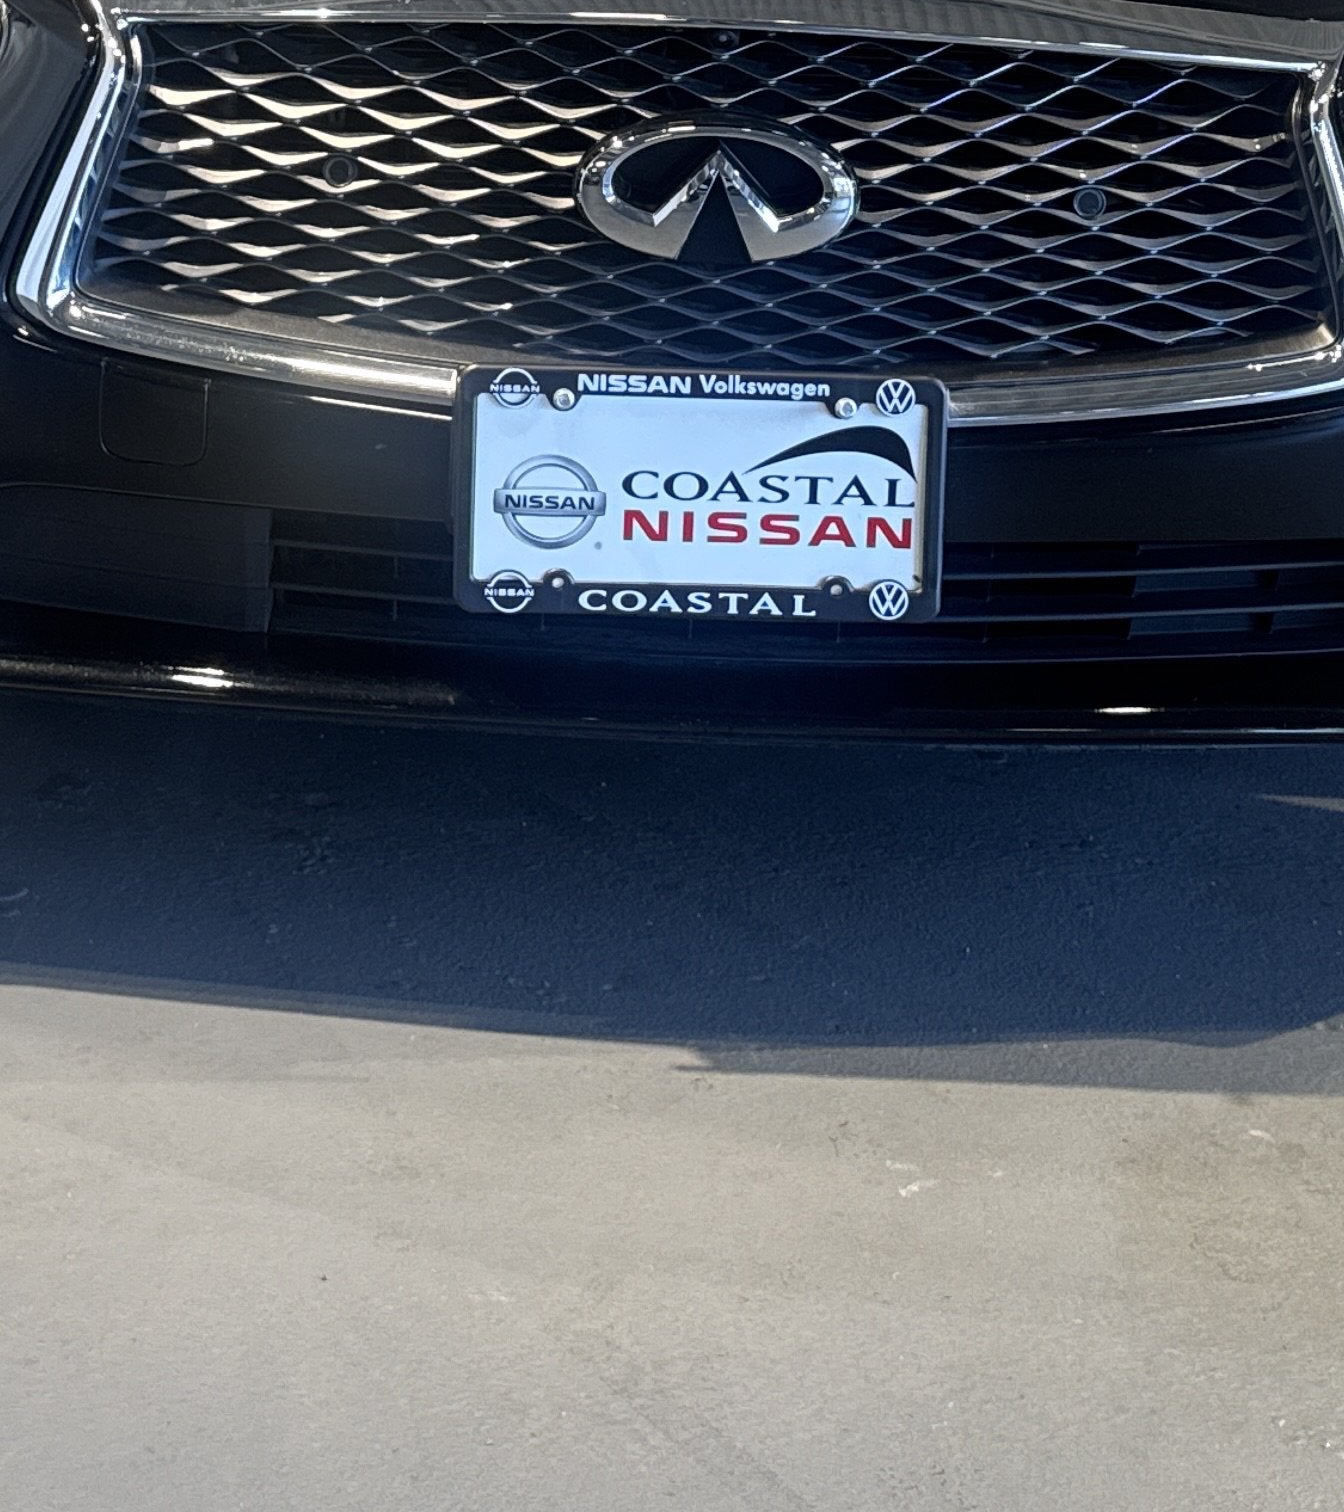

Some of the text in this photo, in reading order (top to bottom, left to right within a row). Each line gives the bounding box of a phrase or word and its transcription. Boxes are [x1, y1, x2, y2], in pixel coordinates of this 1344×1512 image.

[489, 381, 541, 394] NISSAN
[577, 372, 831, 400] NISSAN Volkswagen
[503, 491, 596, 511] NISSAN
[621, 469, 917, 508] COASTAL
[622, 509, 913, 550] NISSAN
[483, 586, 535, 598] NISSAN
[577, 589, 817, 618] COASTAL
